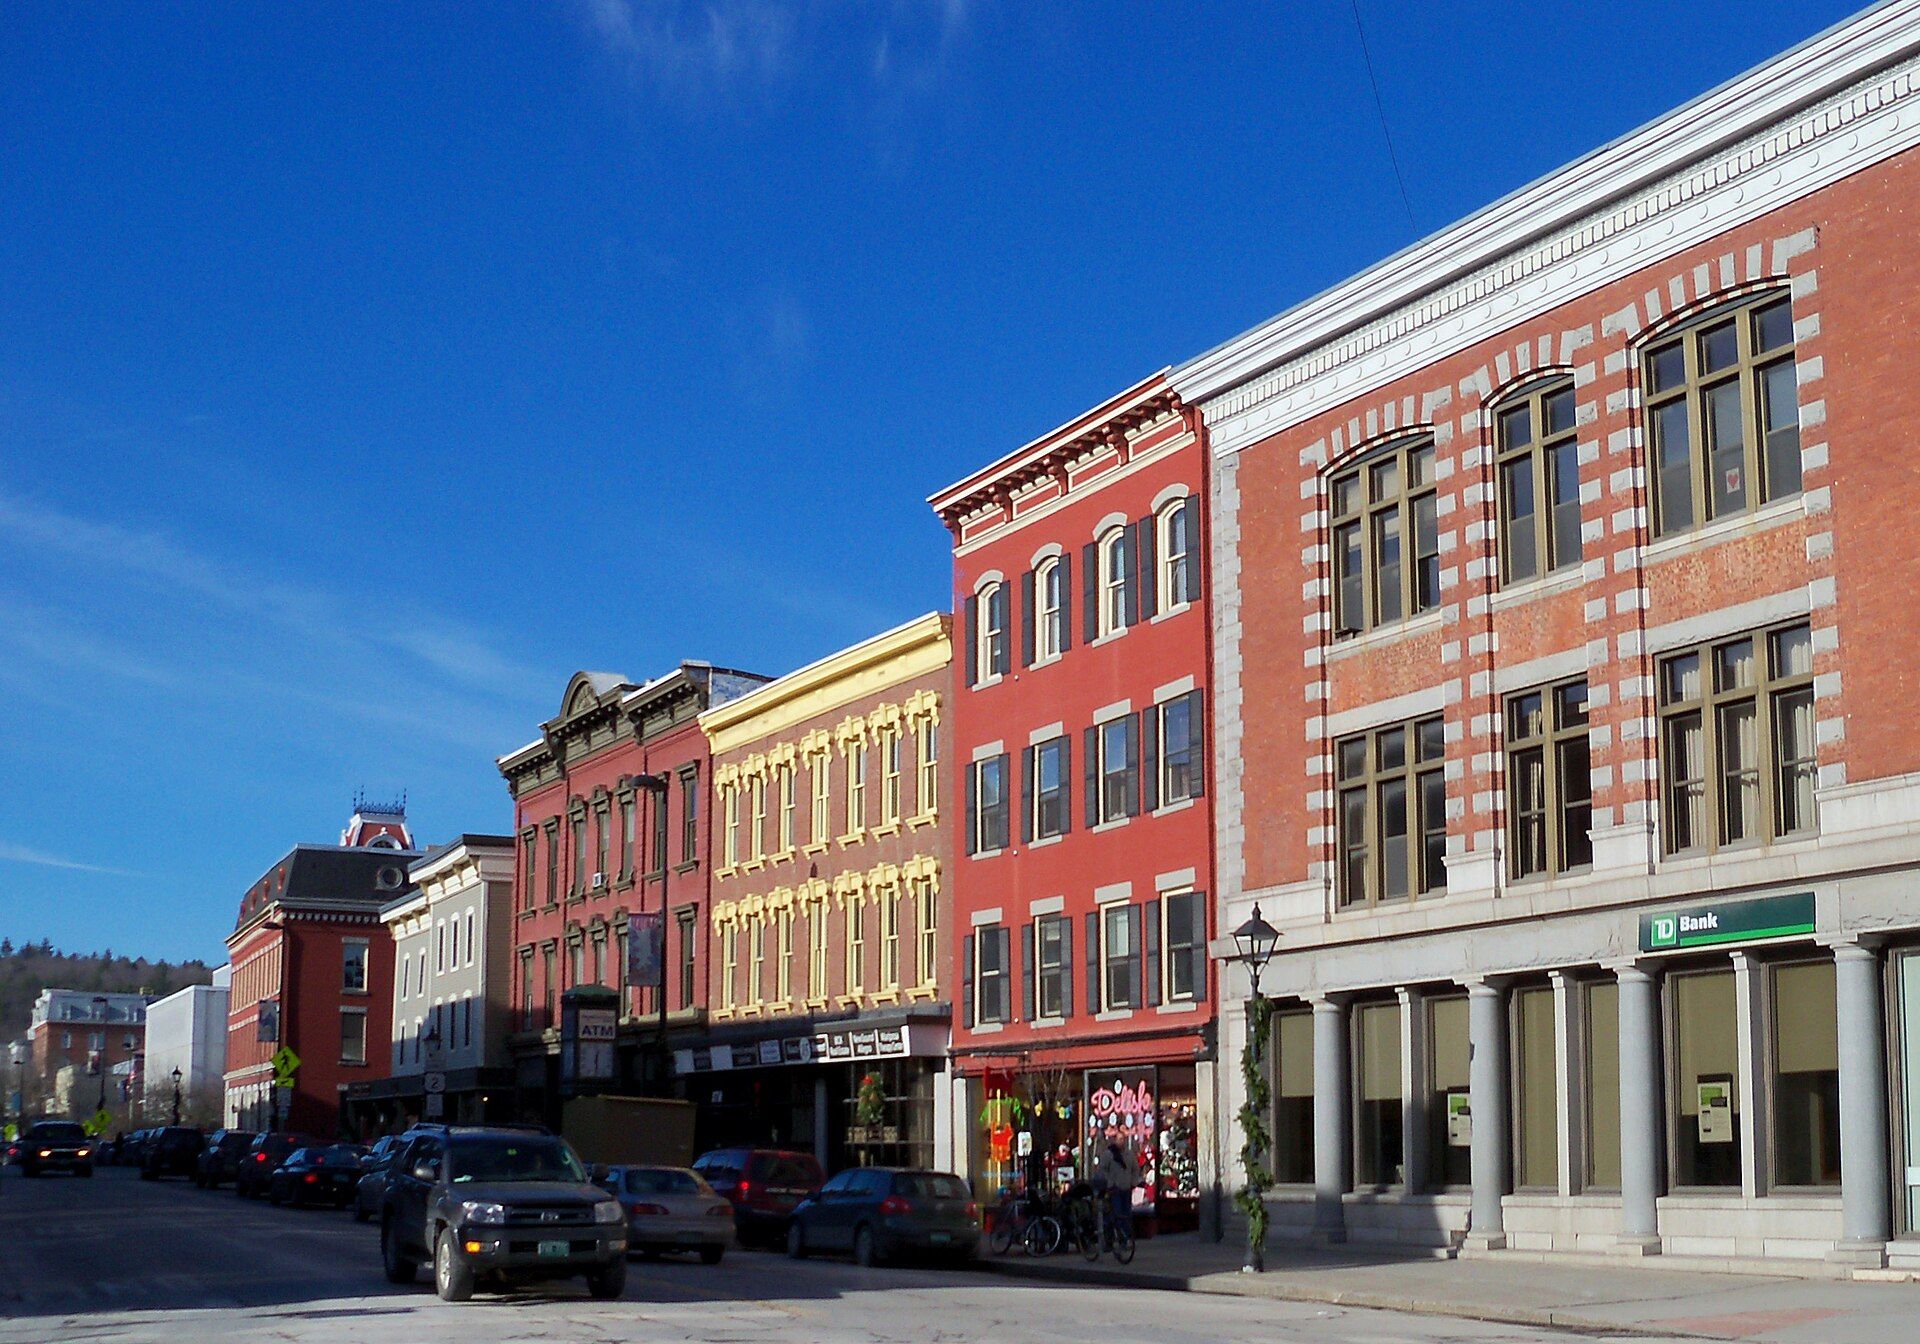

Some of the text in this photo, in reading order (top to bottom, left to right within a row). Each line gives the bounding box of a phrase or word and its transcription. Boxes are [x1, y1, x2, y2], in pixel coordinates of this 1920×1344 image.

[1654, 912, 1718, 940] TD Bank
[582, 1025, 613, 1036] ATM
[1091, 1081, 1151, 1116] Delish
